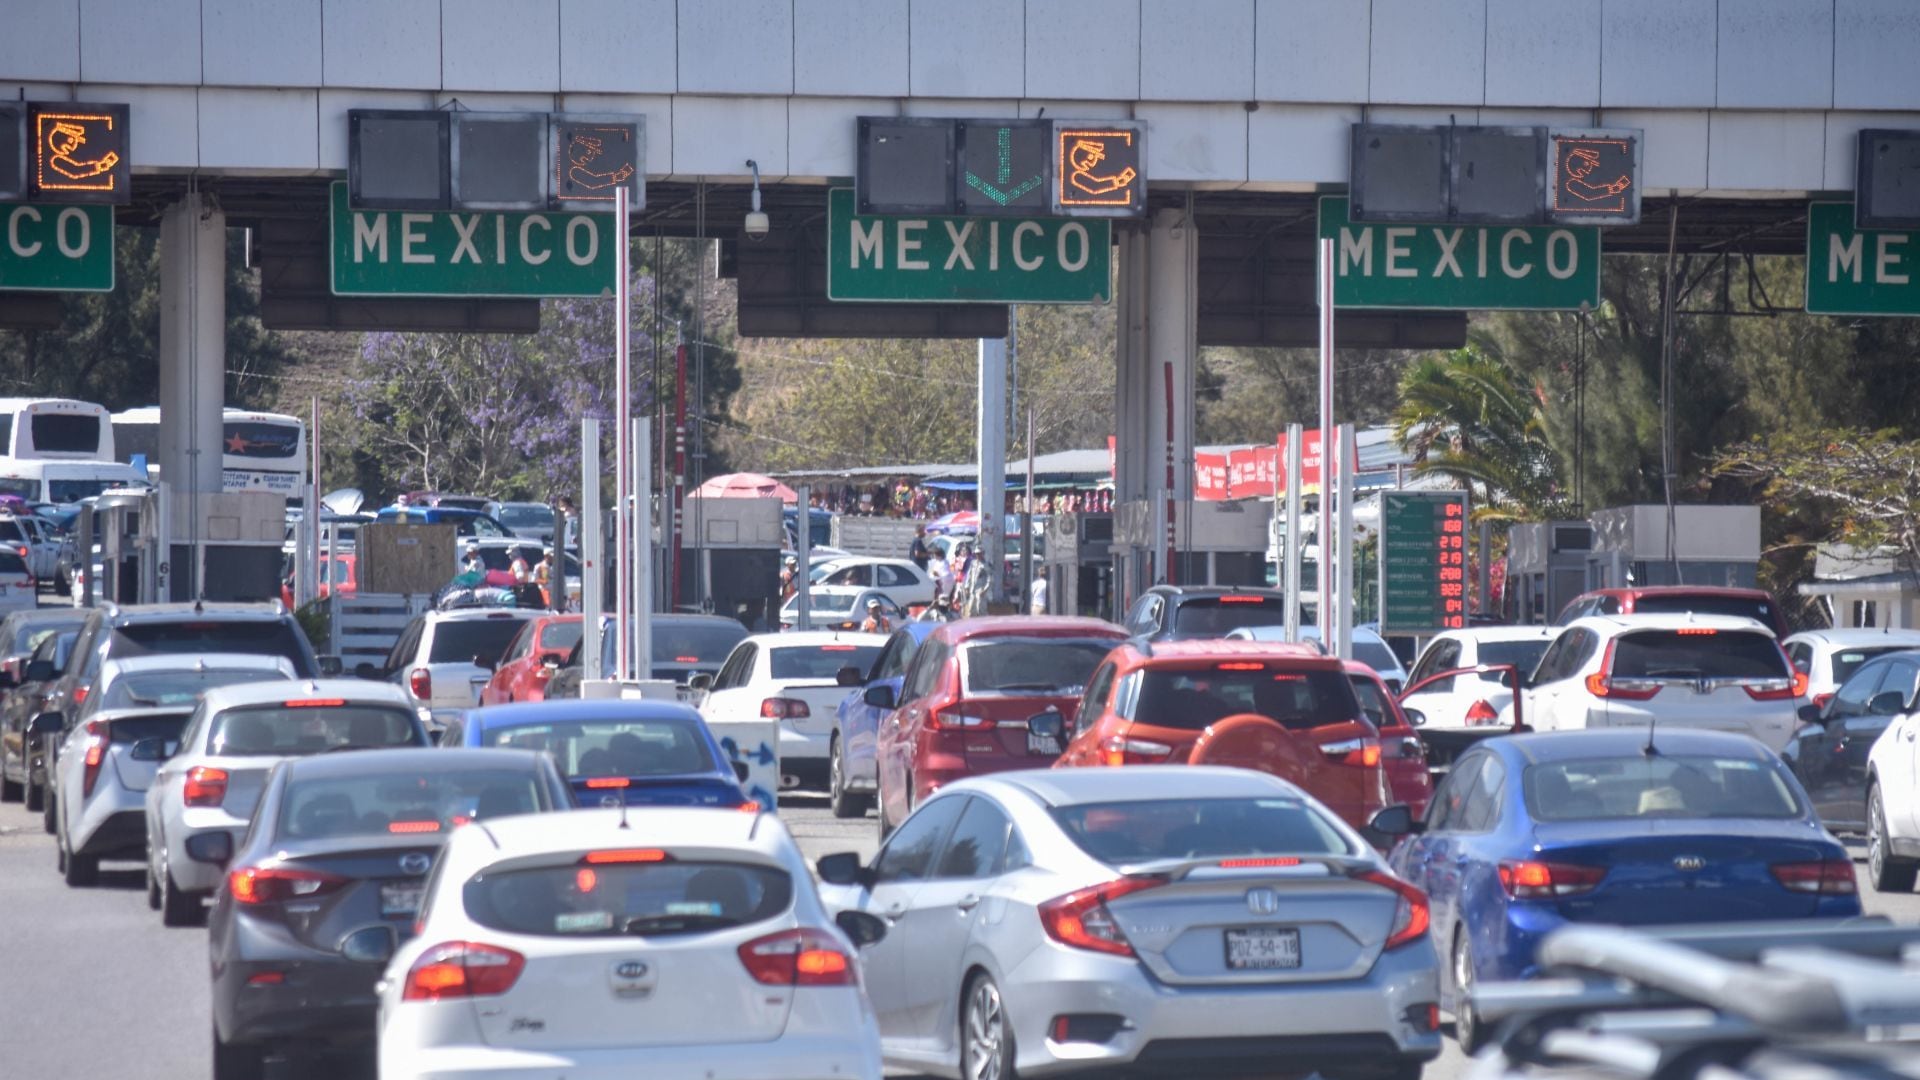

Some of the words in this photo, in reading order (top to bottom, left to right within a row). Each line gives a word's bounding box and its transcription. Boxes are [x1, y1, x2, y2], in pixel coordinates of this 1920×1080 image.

[353, 212, 599, 265] MEXICO
[850, 220, 1090, 272] MEXICO
[1339, 226, 1579, 279] MEXICO
[1446, 504, 1462, 516] 84
[160, 562, 169, 574] 6
[1446, 599, 1462, 612] 84
